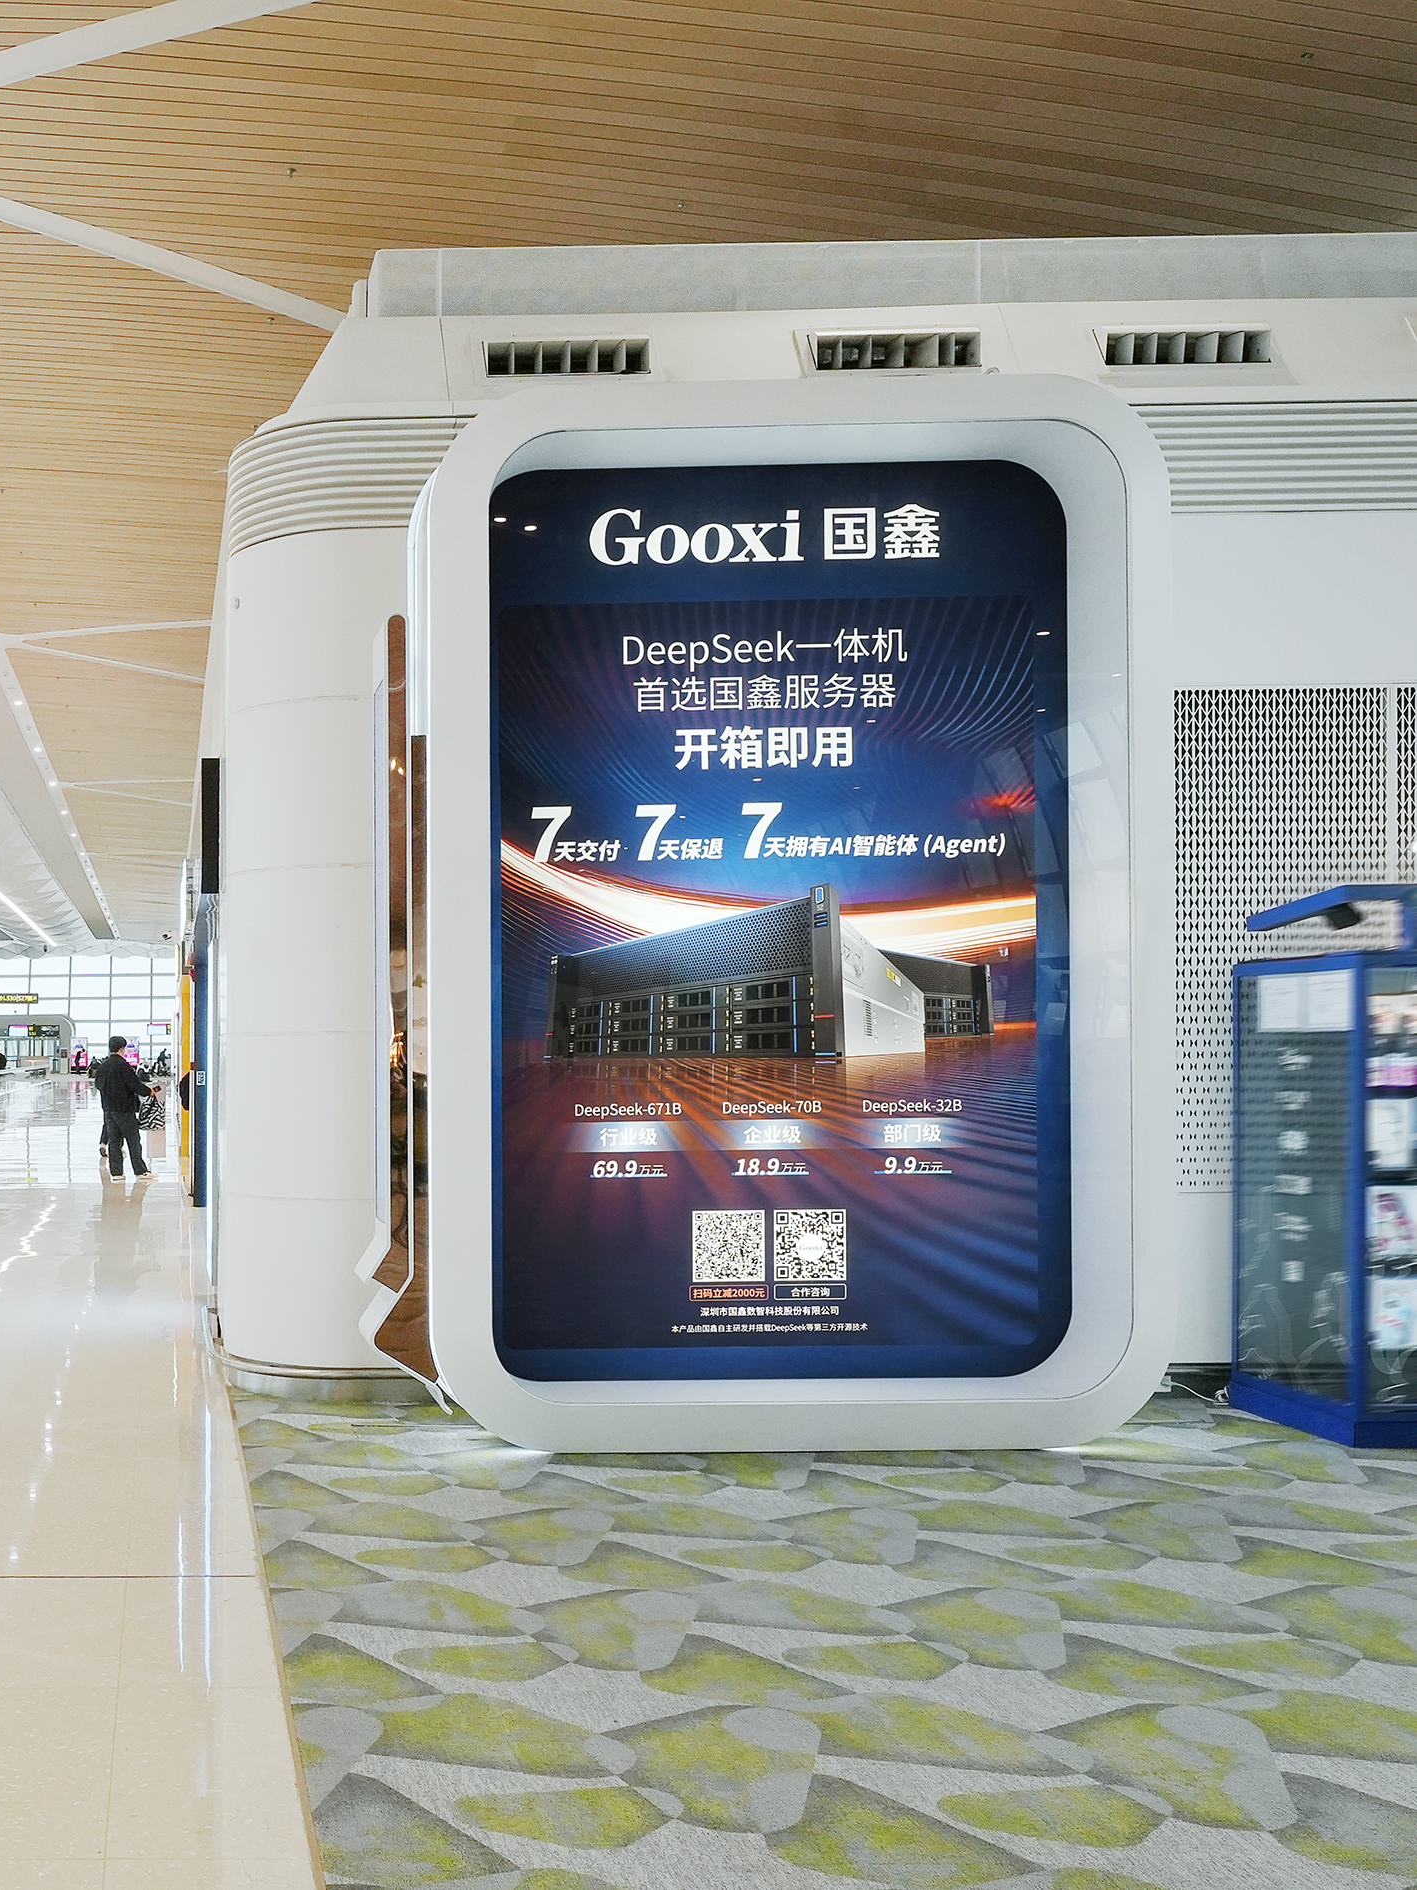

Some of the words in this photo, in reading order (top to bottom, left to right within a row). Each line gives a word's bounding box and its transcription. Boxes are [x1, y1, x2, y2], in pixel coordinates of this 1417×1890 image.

[588, 507, 805, 566] Gooxi
[823, 502, 941, 561] 国鑫
[621, 626, 908, 673] DeepSeek一体机
[632, 672, 897, 714] 首选国鑫服务器
[673, 725, 855, 771] 开箱即用
[573, 1101, 683, 1120] DeepSeek-671B
[721, 1099, 823, 1117] DeepSeek-70B
[861, 1098, 964, 1116] DeepSeek-32B
[598, 1127, 658, 1148] 行业级
[742, 1125, 802, 1146] 企业级
[882, 1123, 942, 1145] 部门级
[692, 1288, 766, 1299] 扫码立减2000元
[790, 1287, 831, 1298] 合作咨询
[699, 1305, 840, 1318] 深圳市国鑫数智科技股份有限公司
